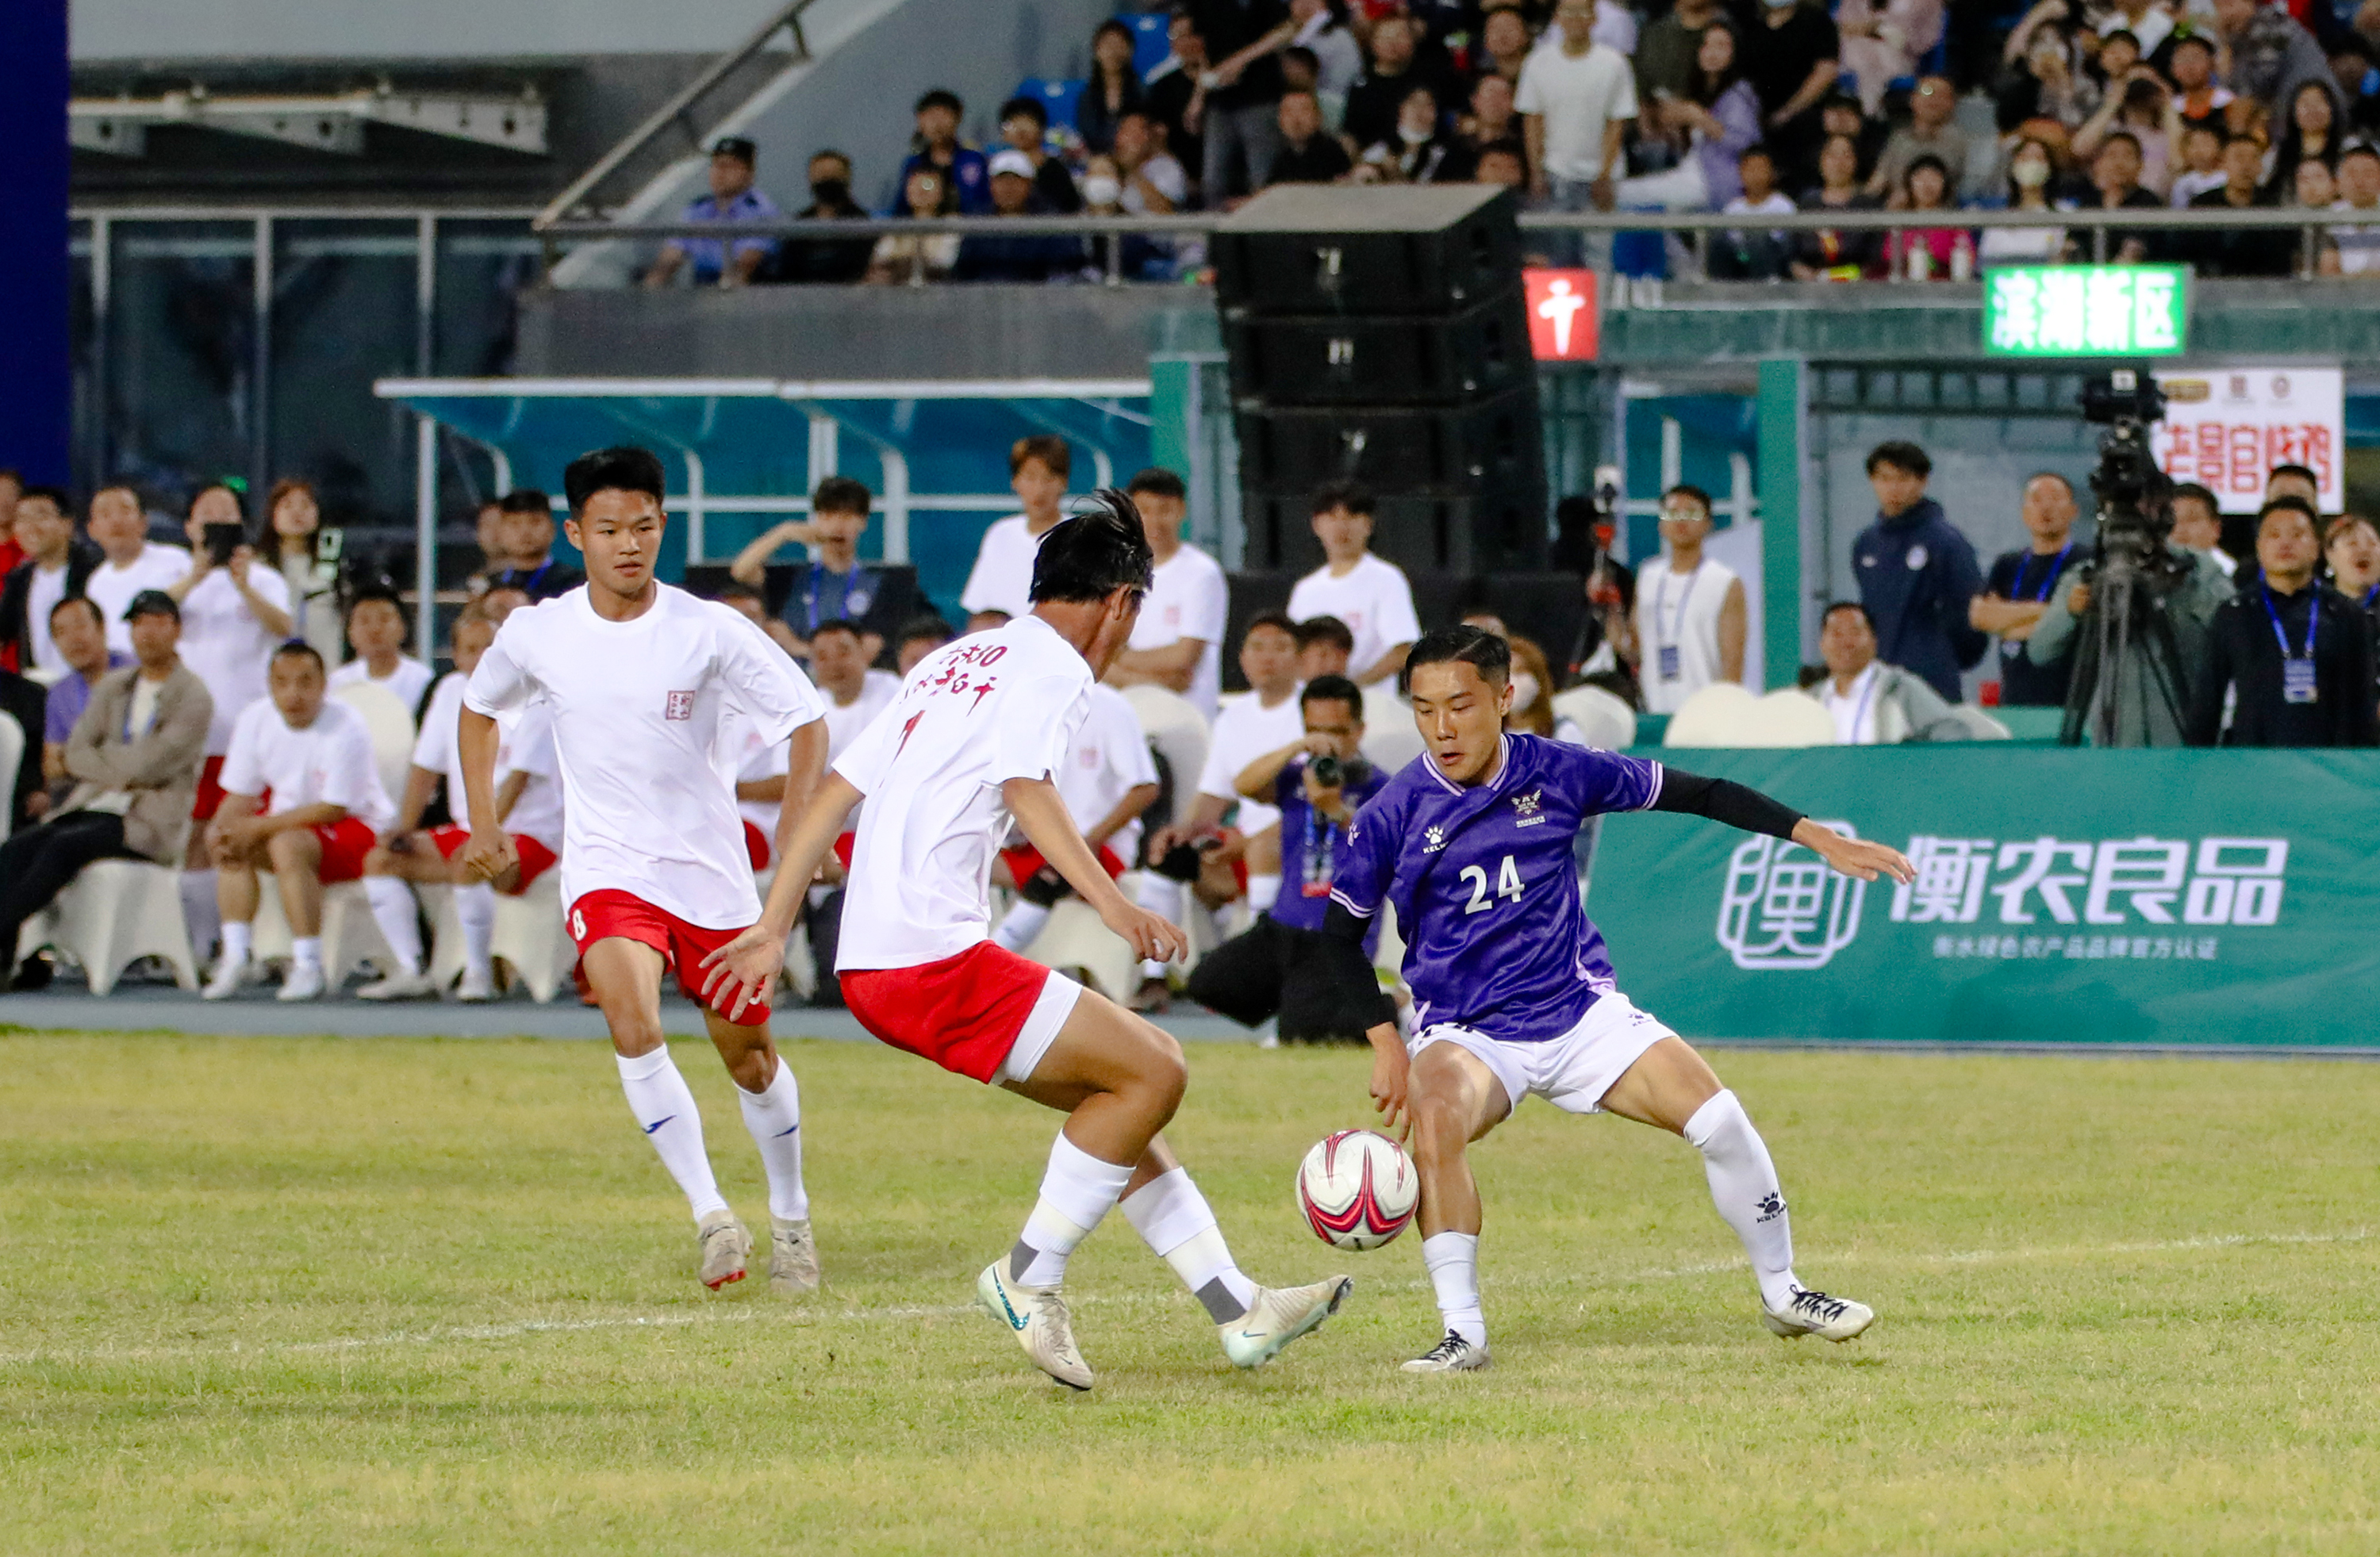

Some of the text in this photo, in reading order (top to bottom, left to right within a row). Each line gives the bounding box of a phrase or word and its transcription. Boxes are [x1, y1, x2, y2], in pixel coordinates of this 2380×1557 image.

[1992, 270, 2177, 351] 滨湖新区
[1459, 854, 1526, 915] 24
[1890, 836, 2290, 926] 衡农良品
[572, 908, 587, 941] 8
